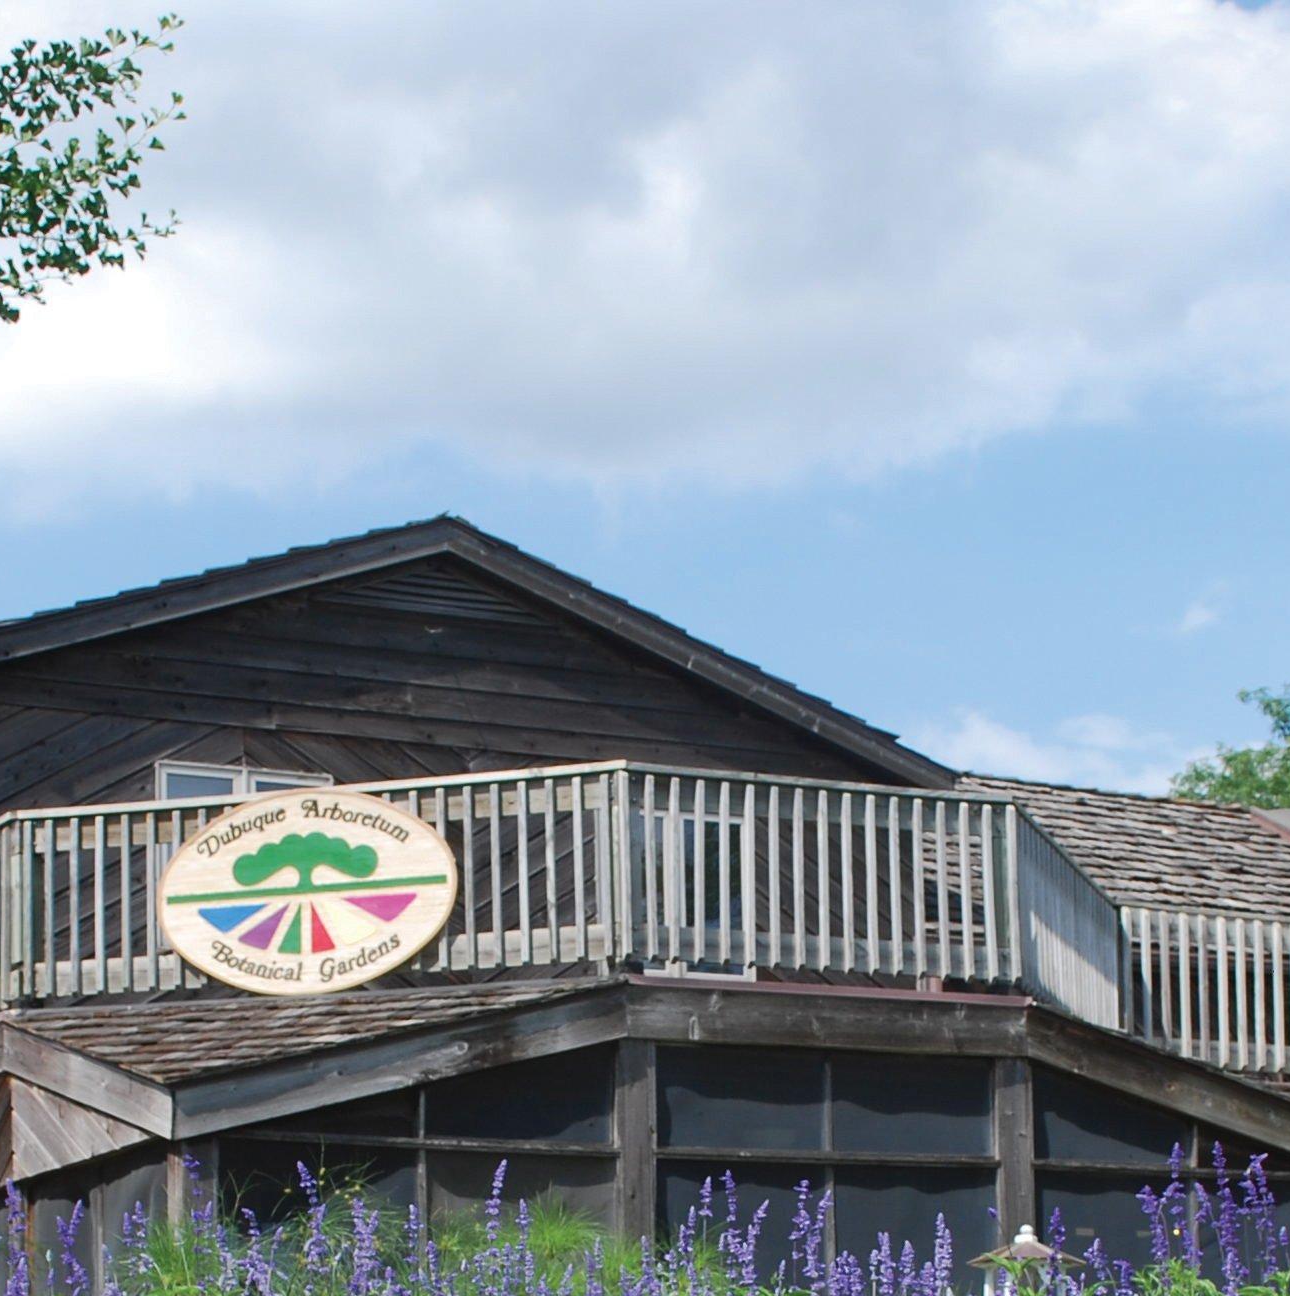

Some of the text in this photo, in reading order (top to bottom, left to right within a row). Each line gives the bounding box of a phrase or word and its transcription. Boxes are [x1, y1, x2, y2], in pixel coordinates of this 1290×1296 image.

[197, 799, 410, 858] Dubuque Arboretum
[211, 933, 401, 982] Botanical Gardens
